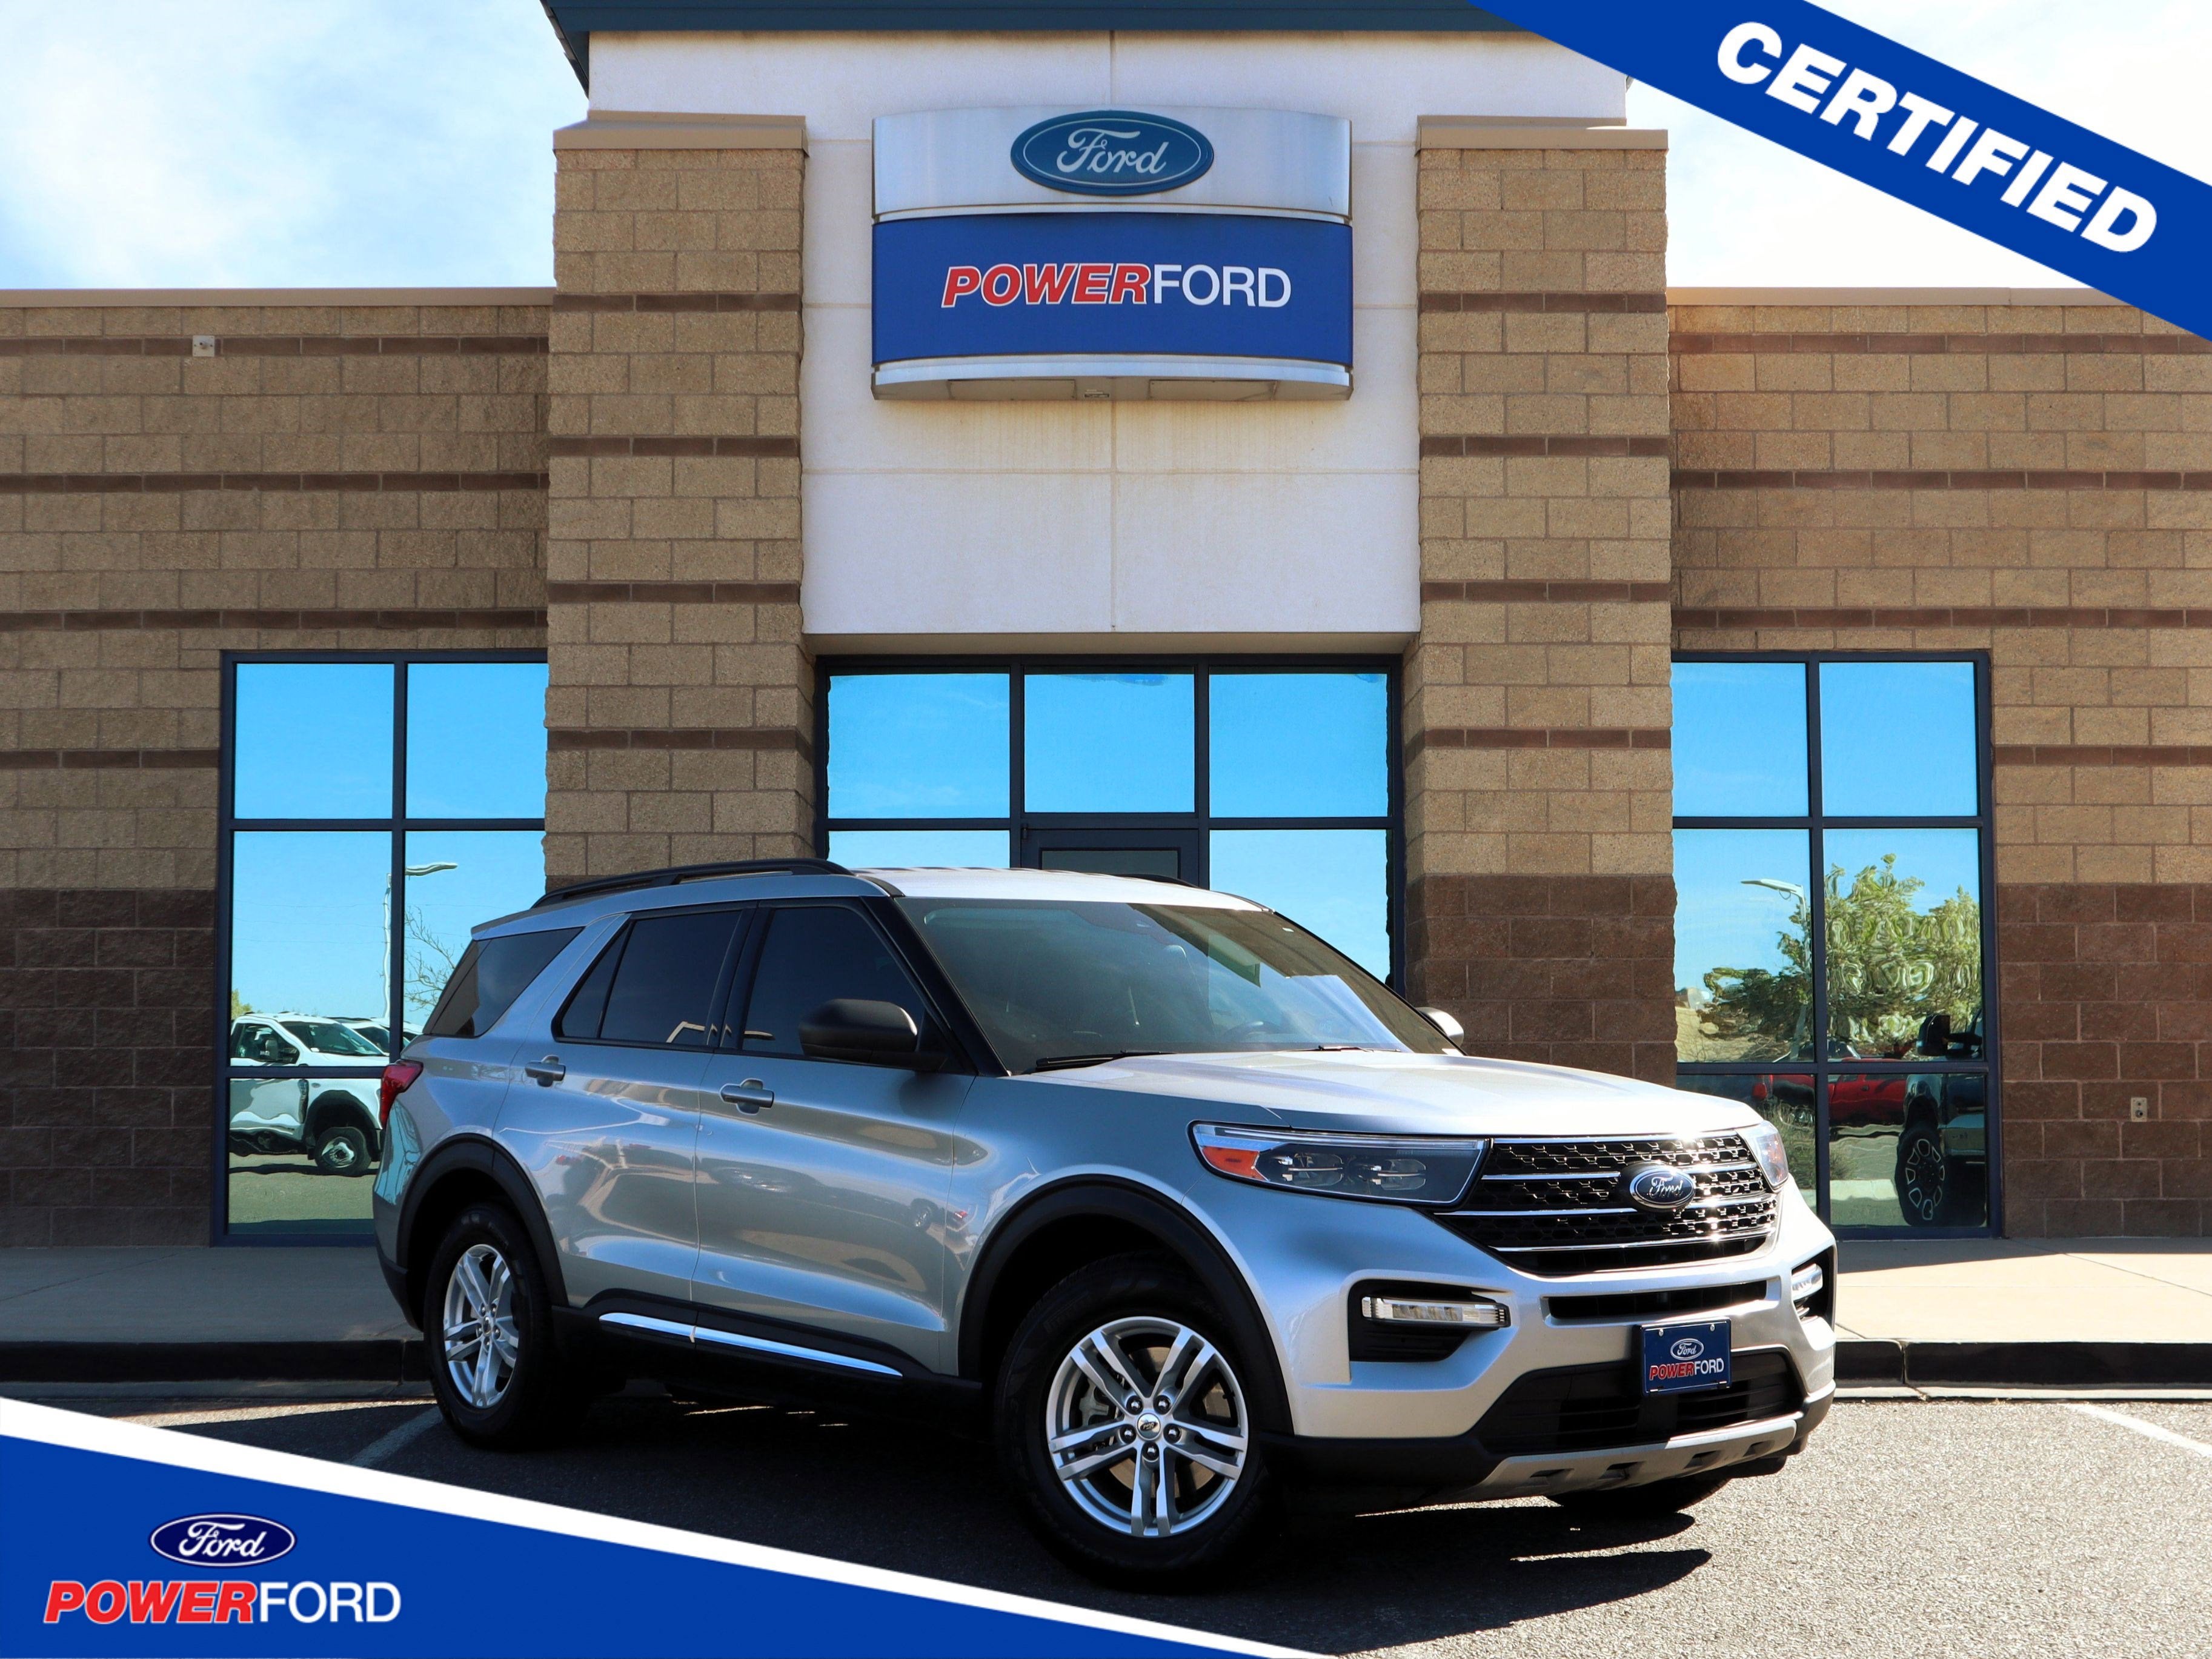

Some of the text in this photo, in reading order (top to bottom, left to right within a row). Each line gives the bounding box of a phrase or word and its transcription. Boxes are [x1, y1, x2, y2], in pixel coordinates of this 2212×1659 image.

[1056, 127, 1168, 173] Ford
[941, 262, 1292, 308] POWERFORD
[1677, 1342, 1697, 1356] Ford
[1649, 1358, 1724, 1381] POWERFORD
